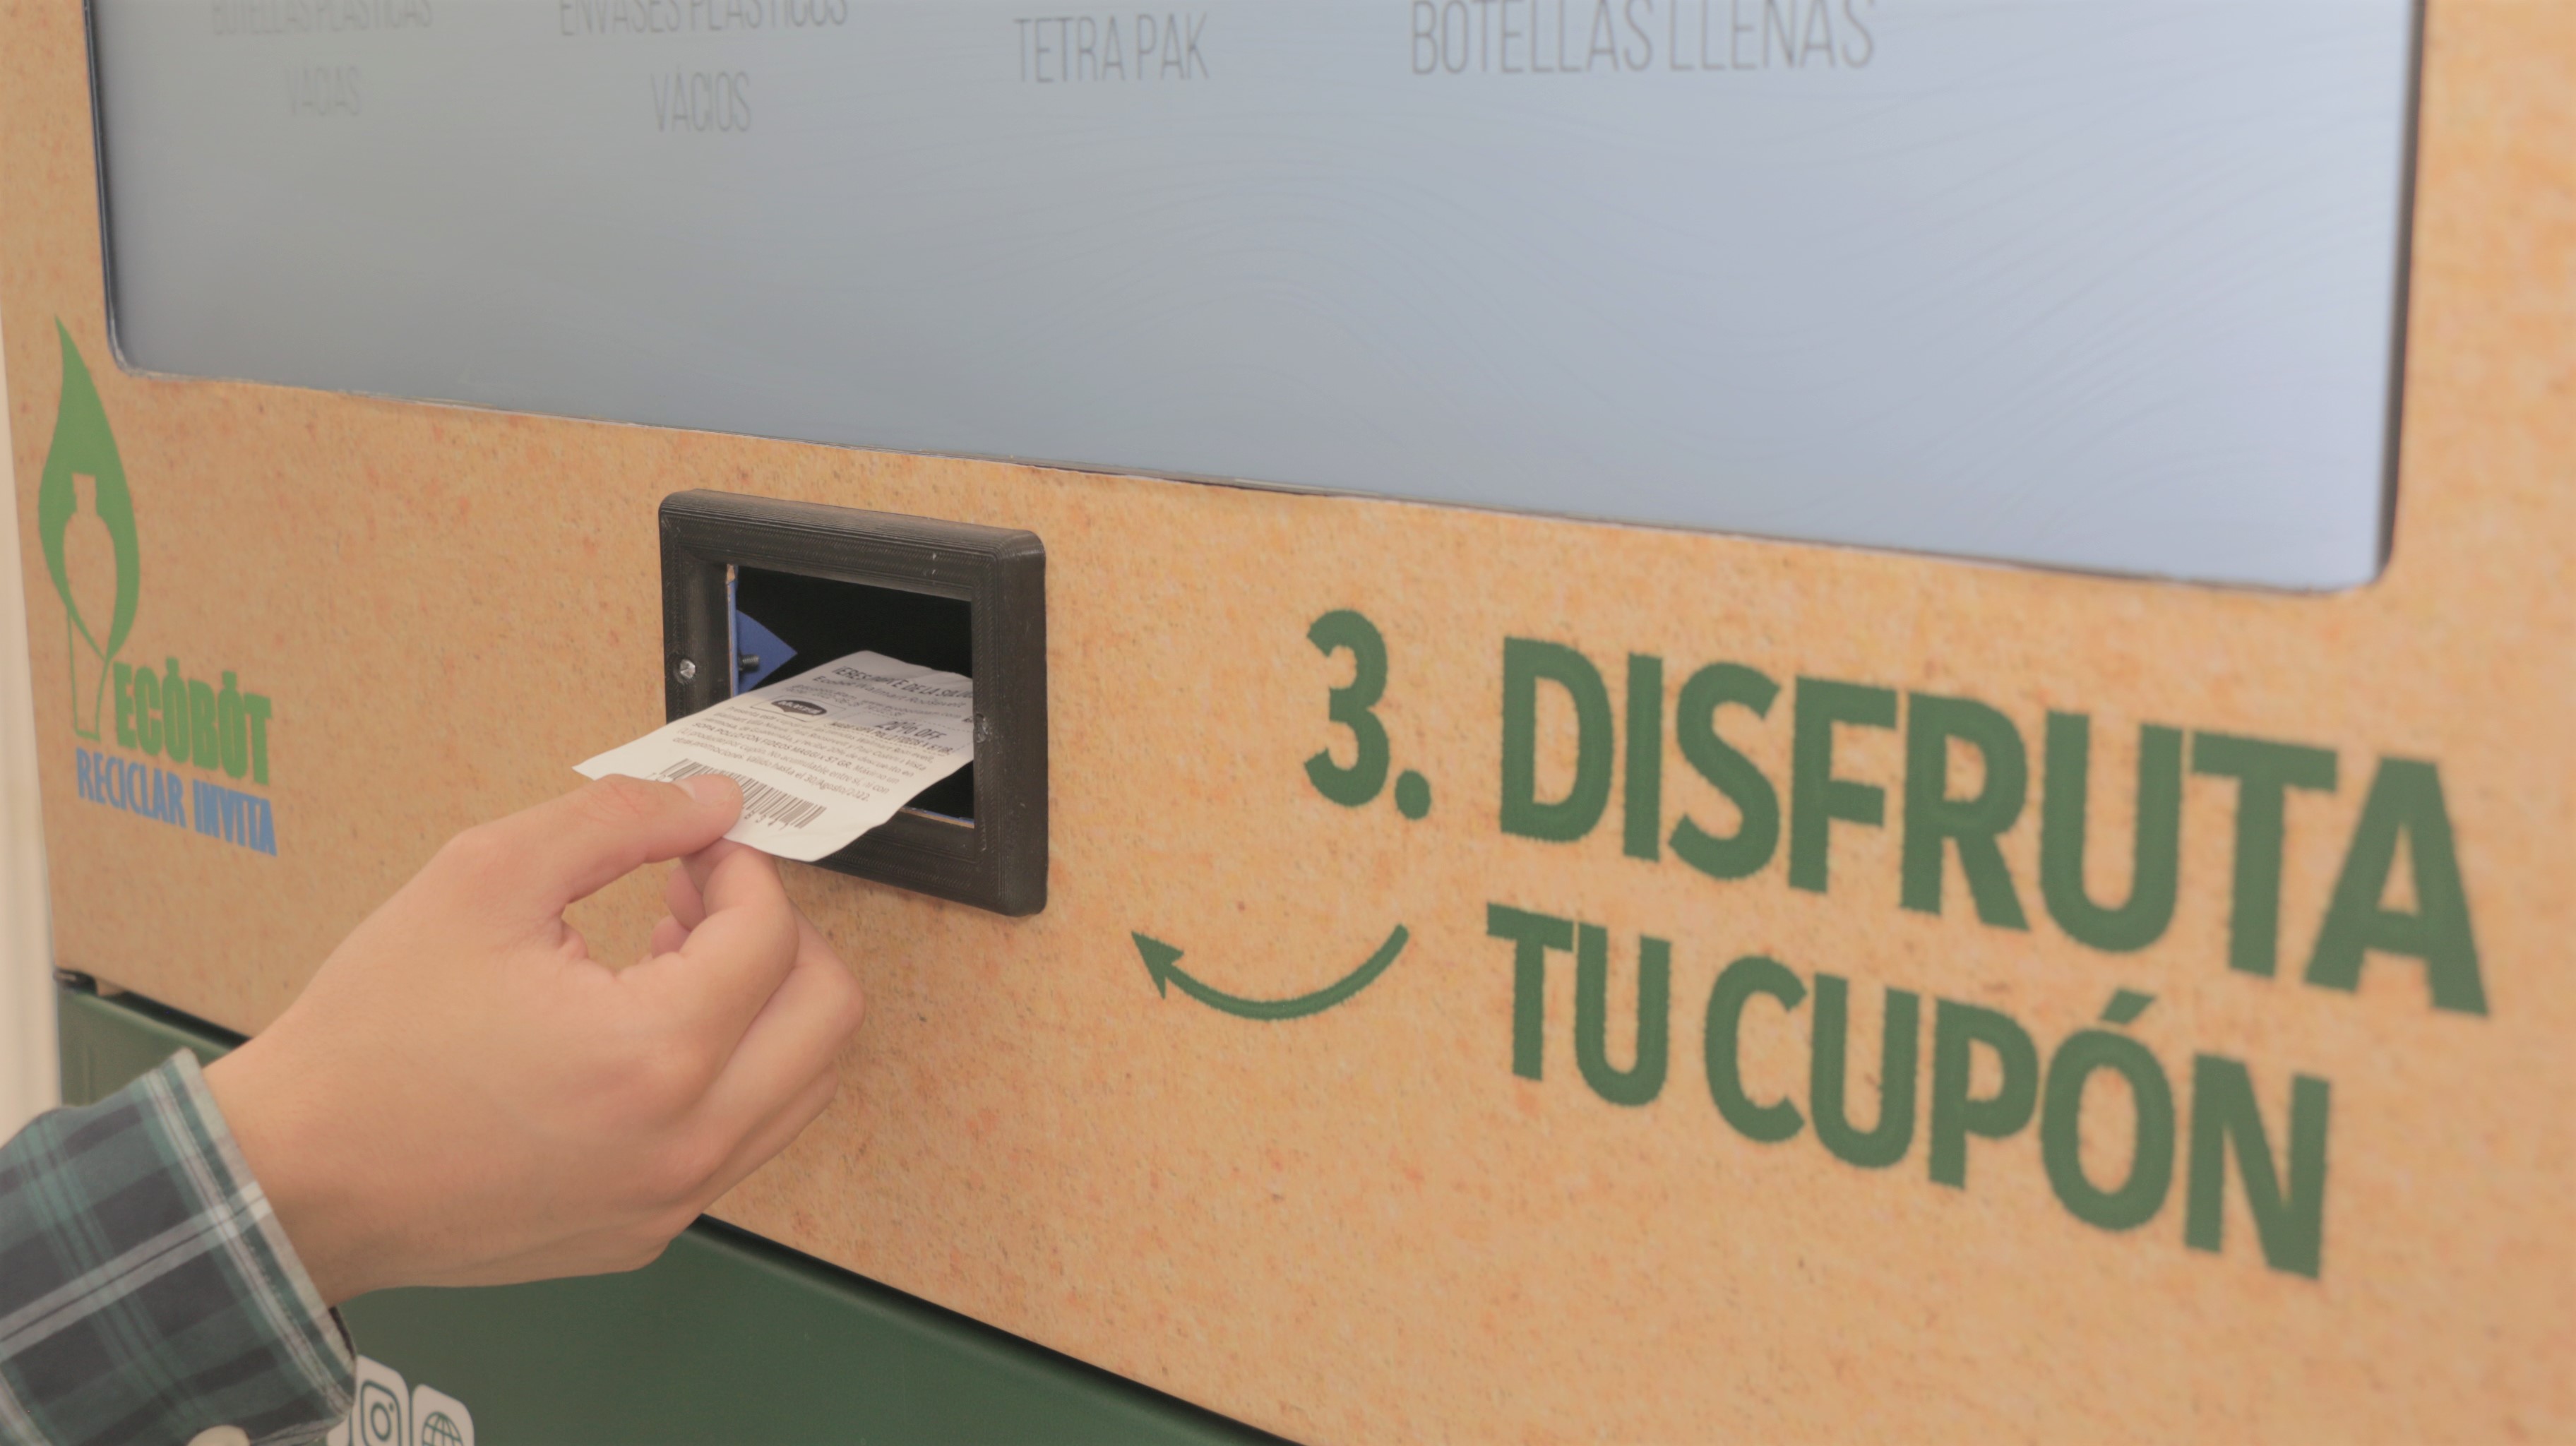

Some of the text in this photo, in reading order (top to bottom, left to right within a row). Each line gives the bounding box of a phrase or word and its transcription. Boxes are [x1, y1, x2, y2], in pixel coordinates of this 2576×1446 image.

[1013, 11, 1210, 83] TETRA PAK
[1411, 0, 1874, 75] BOTELLAS LLENAS
[692, 721, 715, 731] SOPA
[741, 733, 761, 742] CON
[761, 738, 792, 751] FIDEOS
[791, 746, 819, 758] MAGGI
[915, 727, 948, 740] OFF
[1304, 609, 1432, 820] 3.
[76, 746, 278, 857] RECICLAR INVITA
[771, 762, 797, 775] hasta
[1500, 635, 2490, 1017] DISFRUTA
[1486, 902, 2332, 1281] TU CUPÓN
